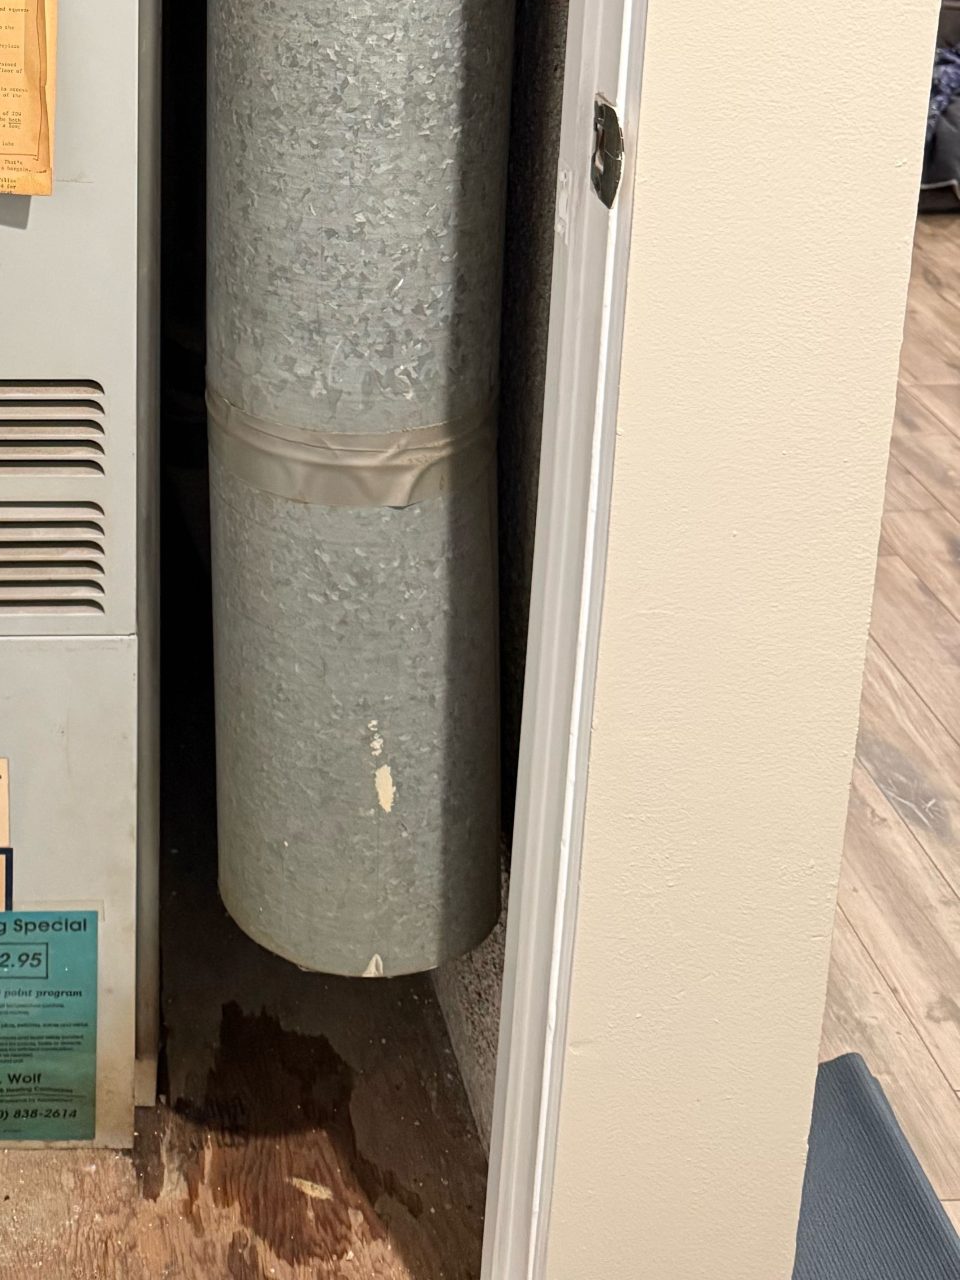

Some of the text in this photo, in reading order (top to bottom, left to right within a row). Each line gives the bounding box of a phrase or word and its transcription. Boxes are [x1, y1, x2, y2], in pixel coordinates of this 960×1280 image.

[13, 918, 87, 934] Special
[4, 988, 32, 999] point
[36, 989, 82, 999] program
[8, 1073, 42, 1084] Wolf
[13, 1108, 77, 1119] 838-2614
